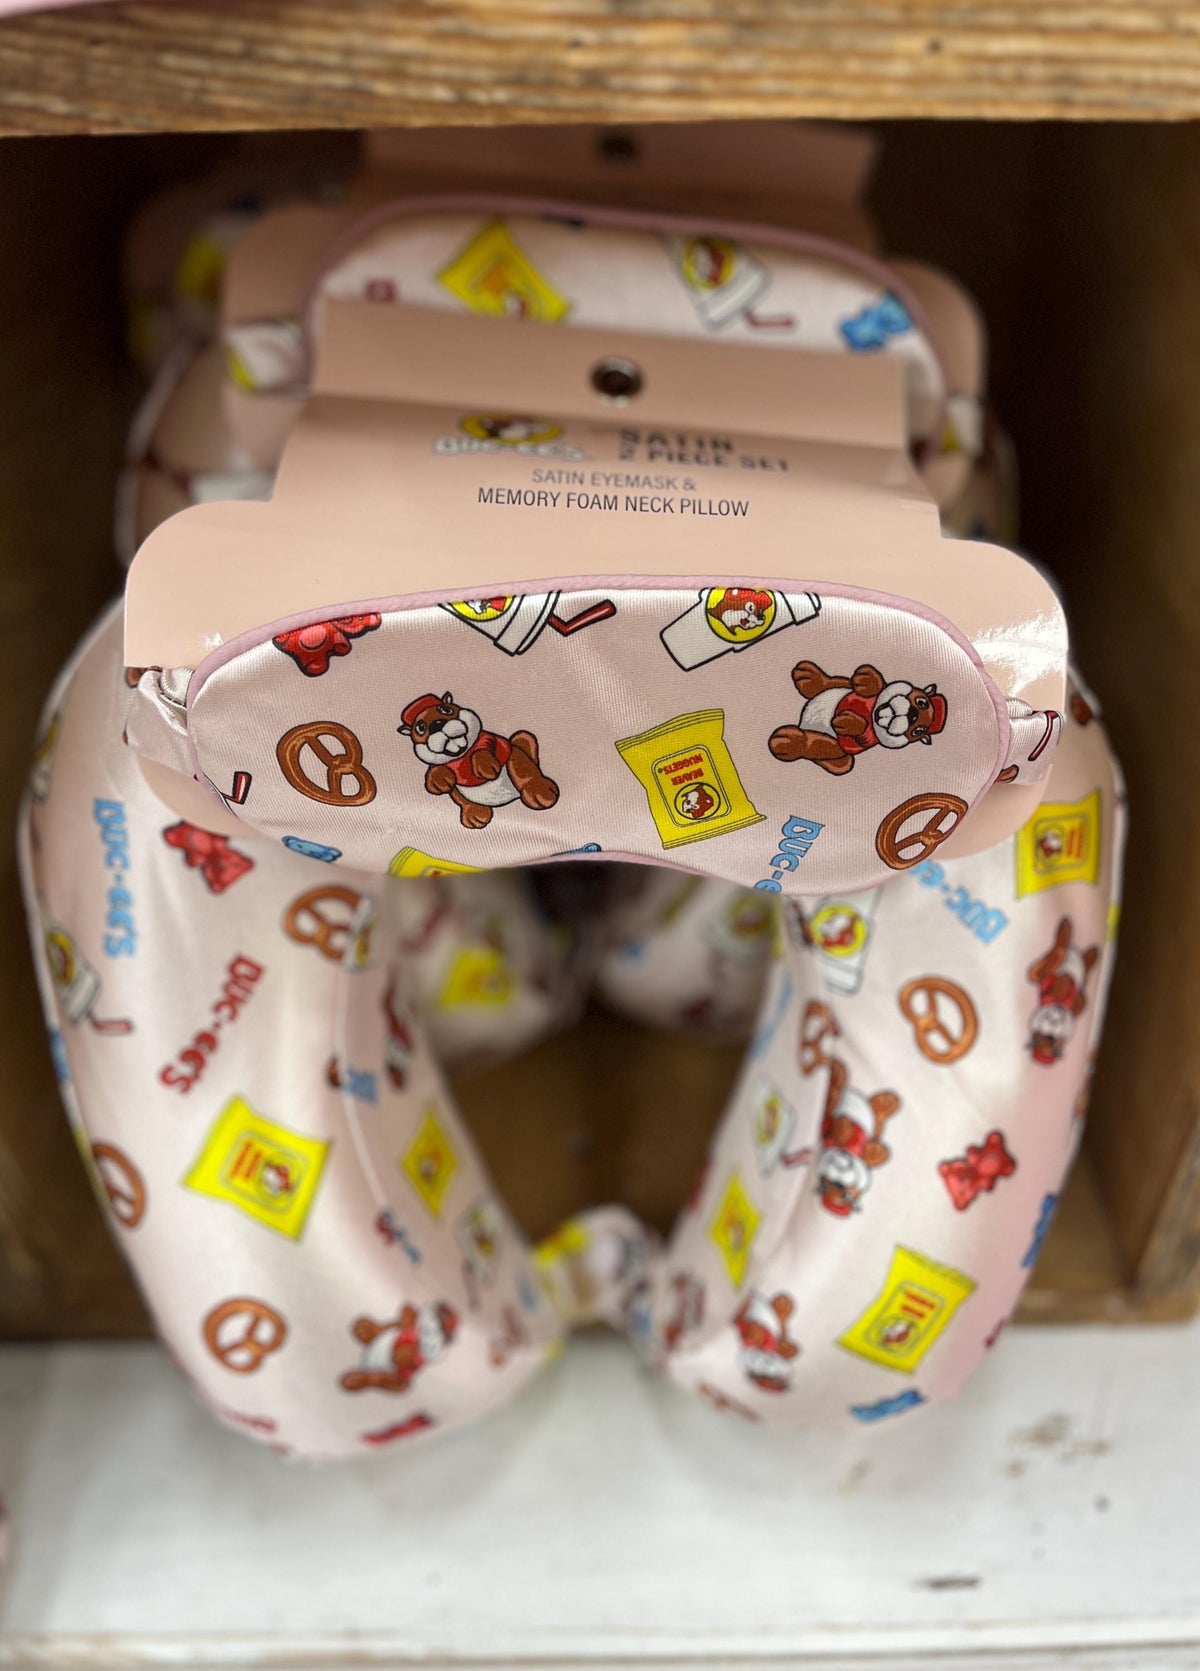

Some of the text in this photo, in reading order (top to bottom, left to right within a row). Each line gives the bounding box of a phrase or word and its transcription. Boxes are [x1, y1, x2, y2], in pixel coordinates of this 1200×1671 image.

[618, 428, 734, 453] SATIN
[647, 447, 730, 467] PIECE
[740, 454, 788, 471] SET
[531, 468, 697, 491] SATIN EYEMASK &
[478, 487, 749, 517] MEMORY FOAM NECK PILLOW
[662, 753, 704, 775] NUGGETS
[670, 767, 705, 786] BEAVER
